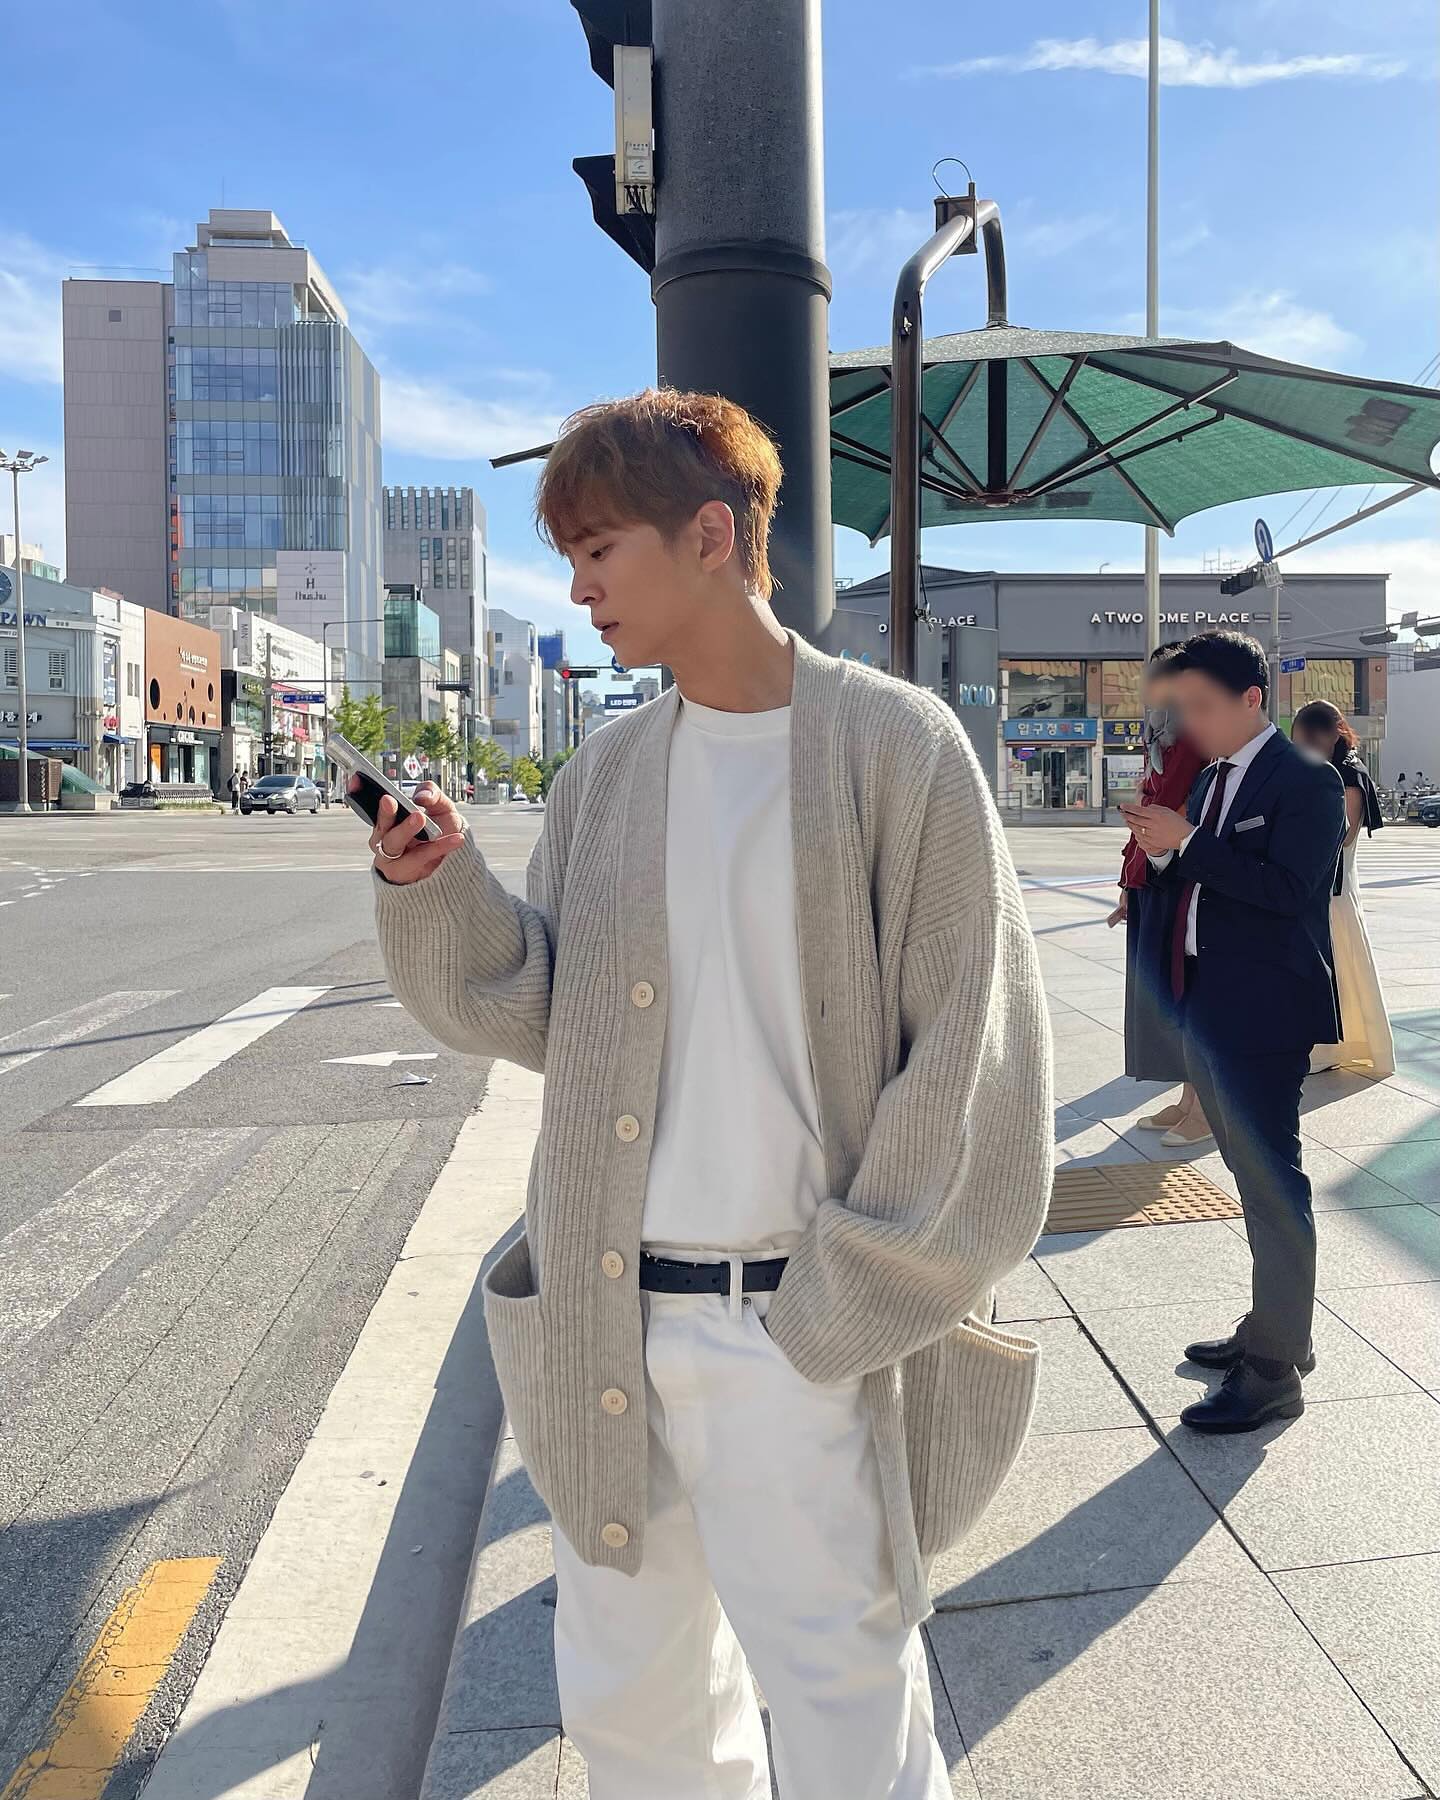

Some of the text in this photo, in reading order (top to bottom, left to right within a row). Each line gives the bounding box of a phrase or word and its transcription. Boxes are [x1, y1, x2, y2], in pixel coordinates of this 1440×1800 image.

[306, 577, 315, 589] H
[1090, 610, 1250, 624] A TWOOME PLACE
